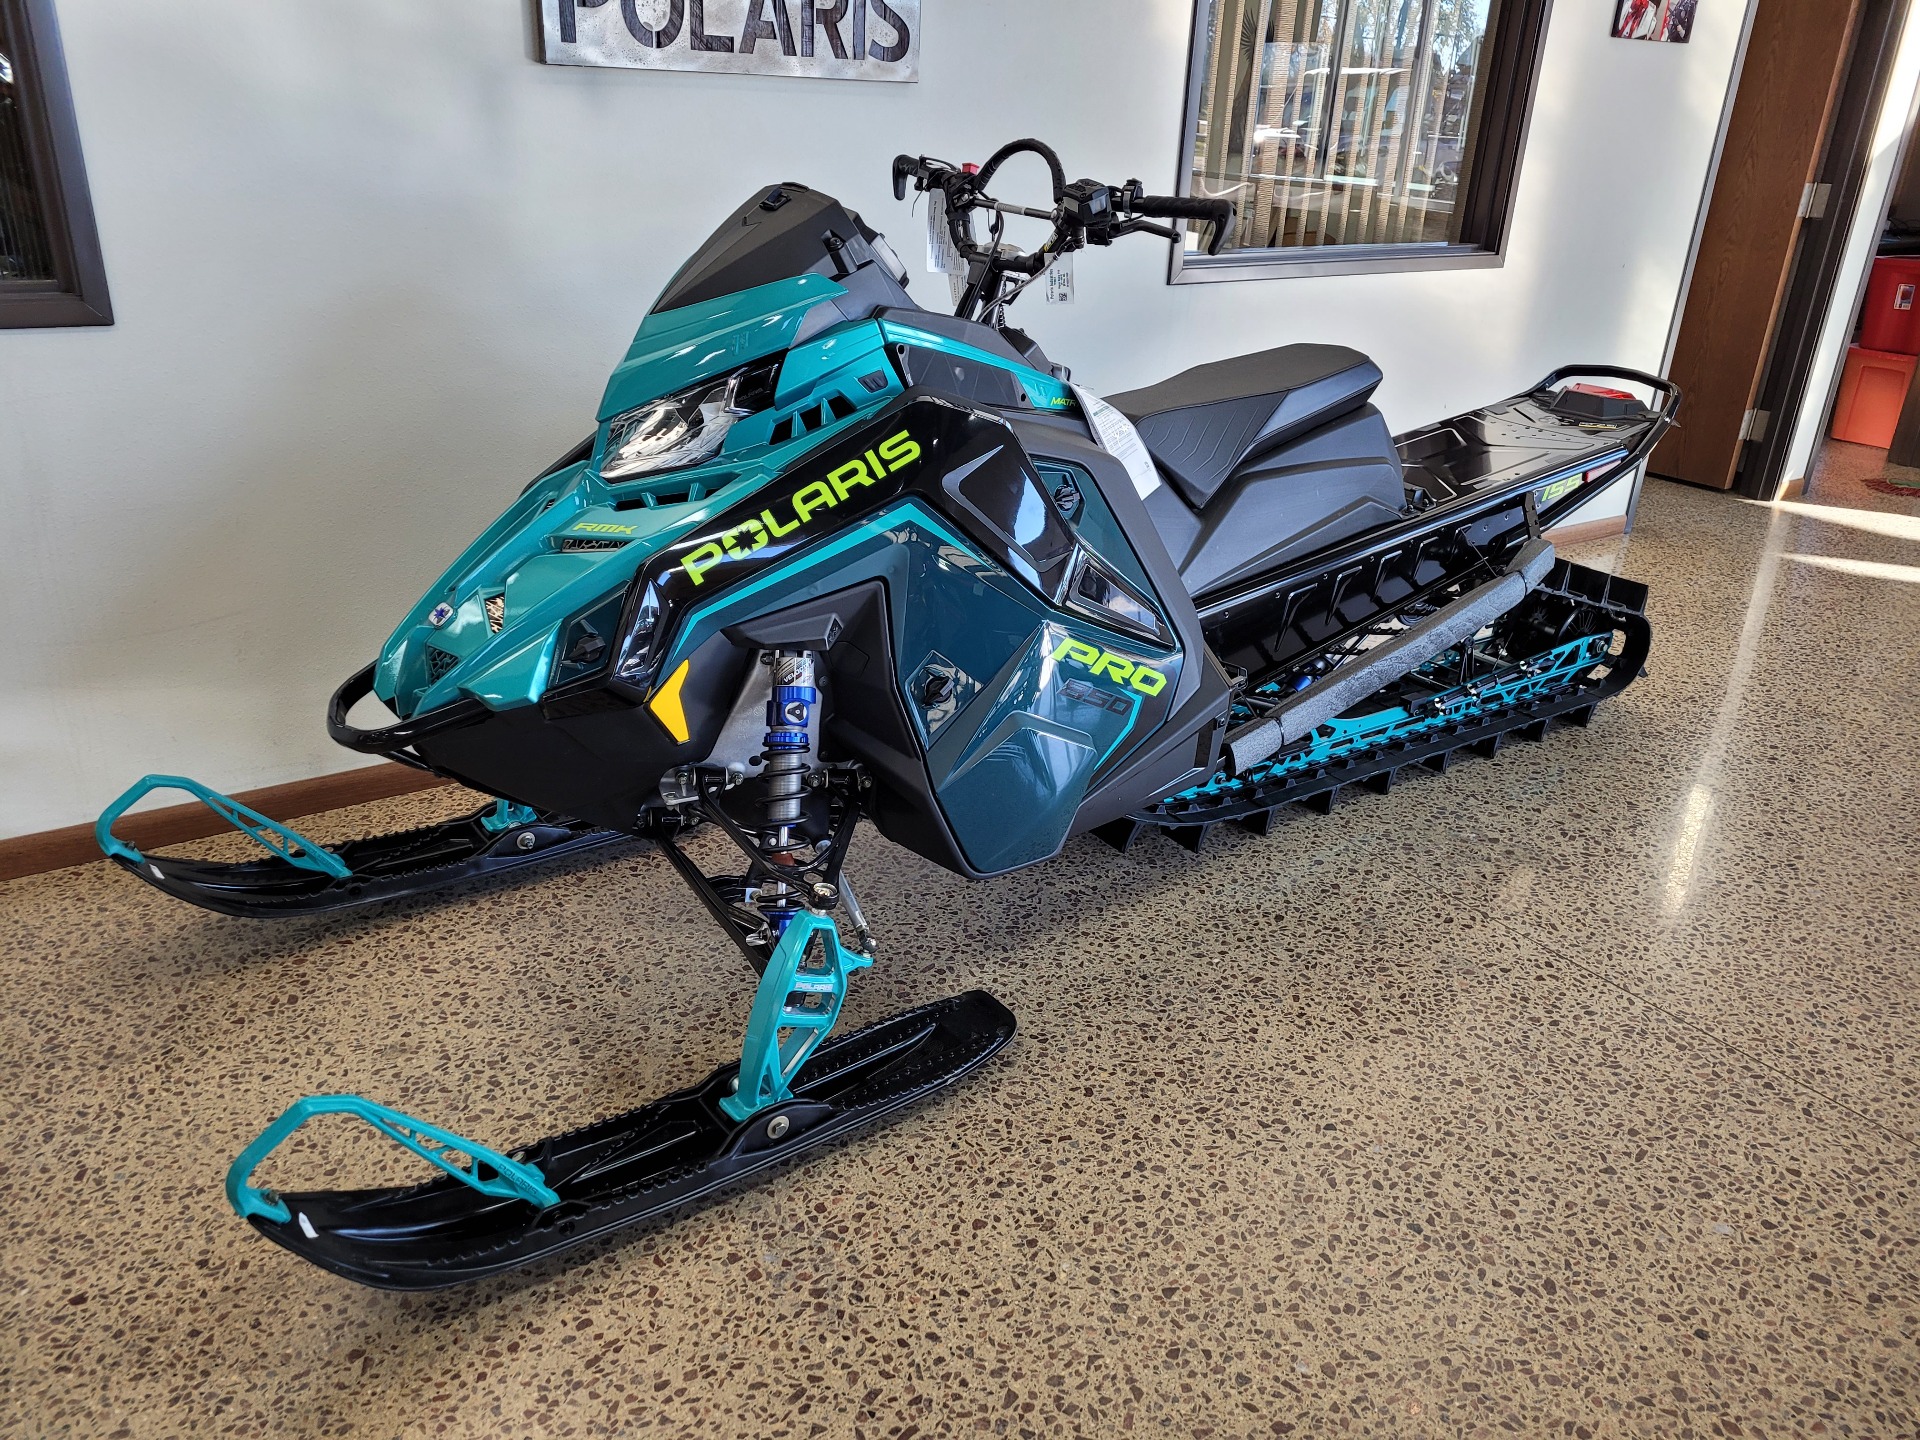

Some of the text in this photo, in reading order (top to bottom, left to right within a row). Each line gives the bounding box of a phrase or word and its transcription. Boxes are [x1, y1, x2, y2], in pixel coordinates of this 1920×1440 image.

[1050, 396, 1076, 407] MATR
[1541, 473, 1581, 502] 155
[680, 429, 921, 586] POLARIS
[572, 522, 639, 535] RMK
[1052, 637, 1167, 697] PRO
[1056, 678, 1134, 716] 850
[793, 981, 834, 993] POLARIS
[496, 1163, 538, 1196] POLARIS
